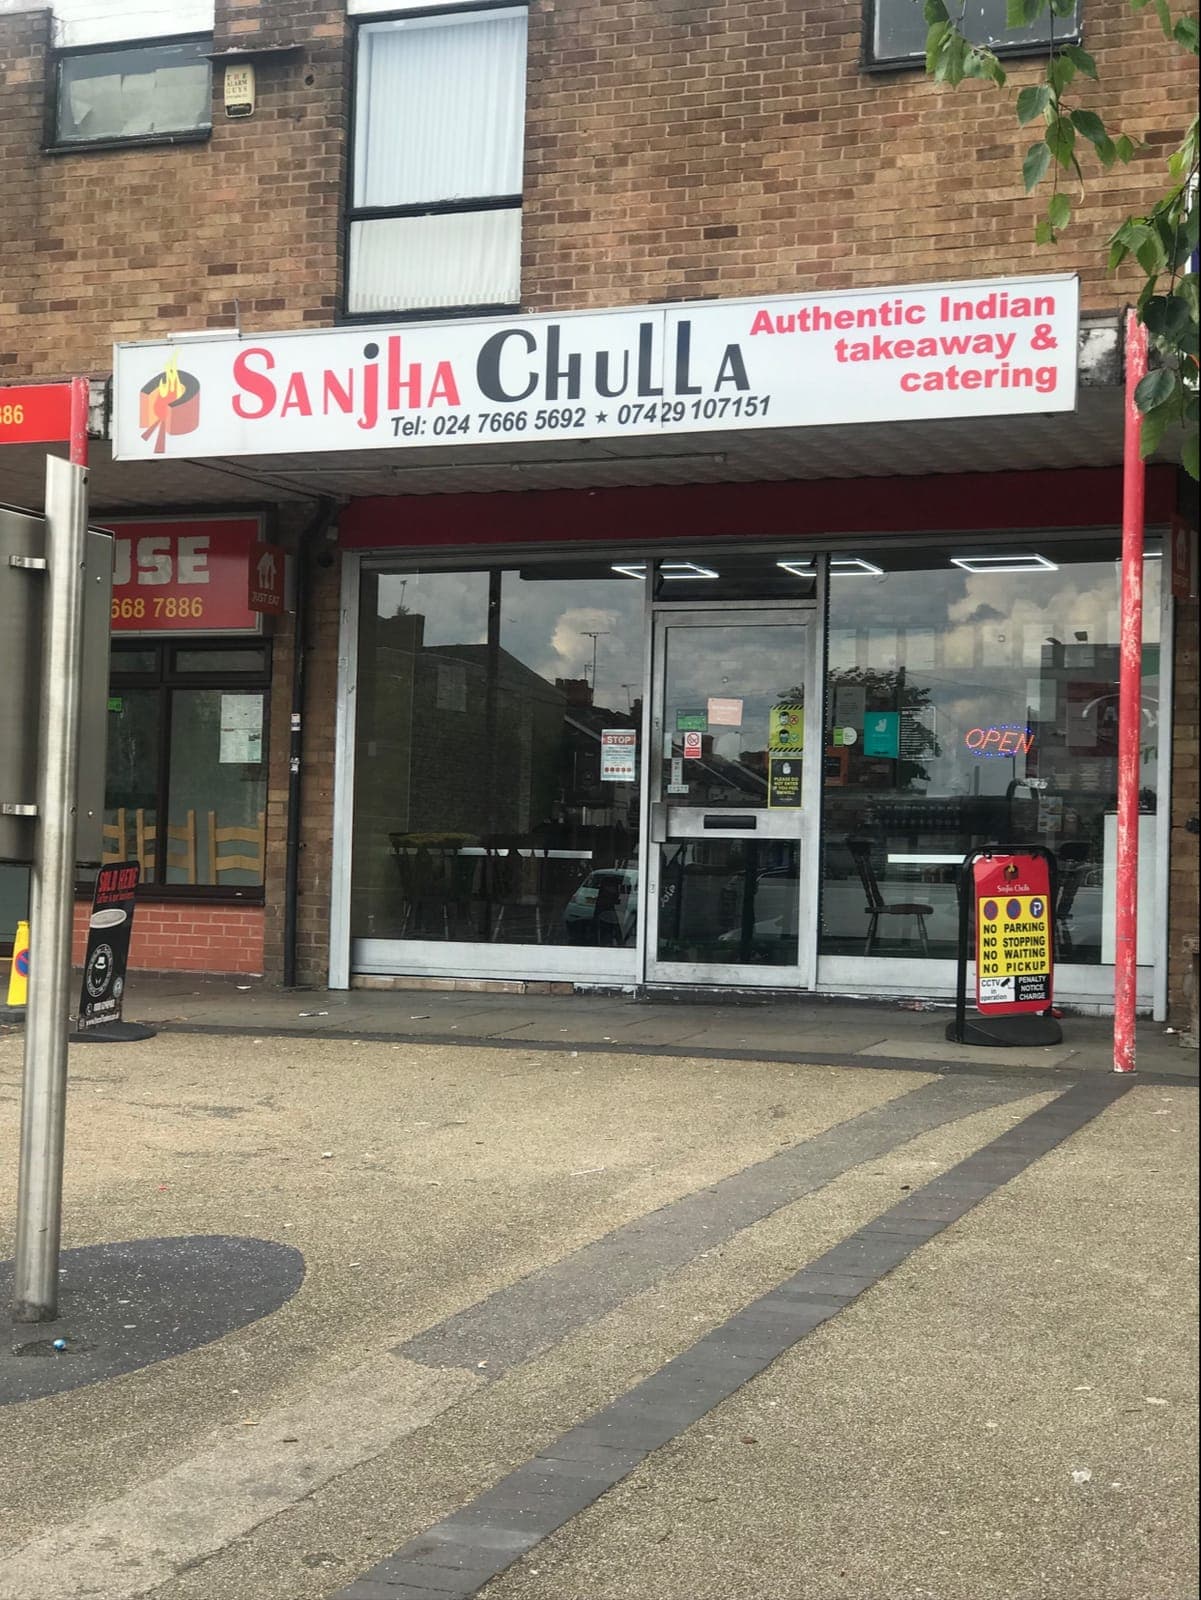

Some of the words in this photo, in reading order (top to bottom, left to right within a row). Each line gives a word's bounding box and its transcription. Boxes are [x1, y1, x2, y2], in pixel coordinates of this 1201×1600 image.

[750, 299, 926, 336] Authentic
[940, 292, 1056, 322] Indian
[834, 331, 1017, 363] takeaway
[1030, 323, 1059, 350] &
[900, 362, 1058, 393] catering
[0, 404, 24, 425] 86
[391, 415, 427, 437] Tel:
[433, 413, 470, 436] 024
[478, 411, 528, 433] 7666
[534, 407, 586, 430] 5692
[617, 401, 686, 425] 07429
[691, 395, 771, 420] 107151
[153, 597, 203, 618] 7886
[607, 735, 632, 744] STOP
[965, 727, 1036, 754] OPEN
[983, 924, 998, 934] NO
[1003, 922, 1045, 933] PARKING
[983, 937, 998, 947] NO
[1002, 936, 1046, 948] STOPPING
[983, 950, 998, 960] NO
[1004, 948, 1046, 959] WAITING
[983, 963, 998, 974] NO
[1006, 960, 1046, 972] PICKUP
[981, 979, 1001, 987] CCTV
[1018, 976, 1047, 984] PENALTY
[1020, 984, 1044, 992] NOTICE
[1019, 992, 1046, 1000] CHARGE
